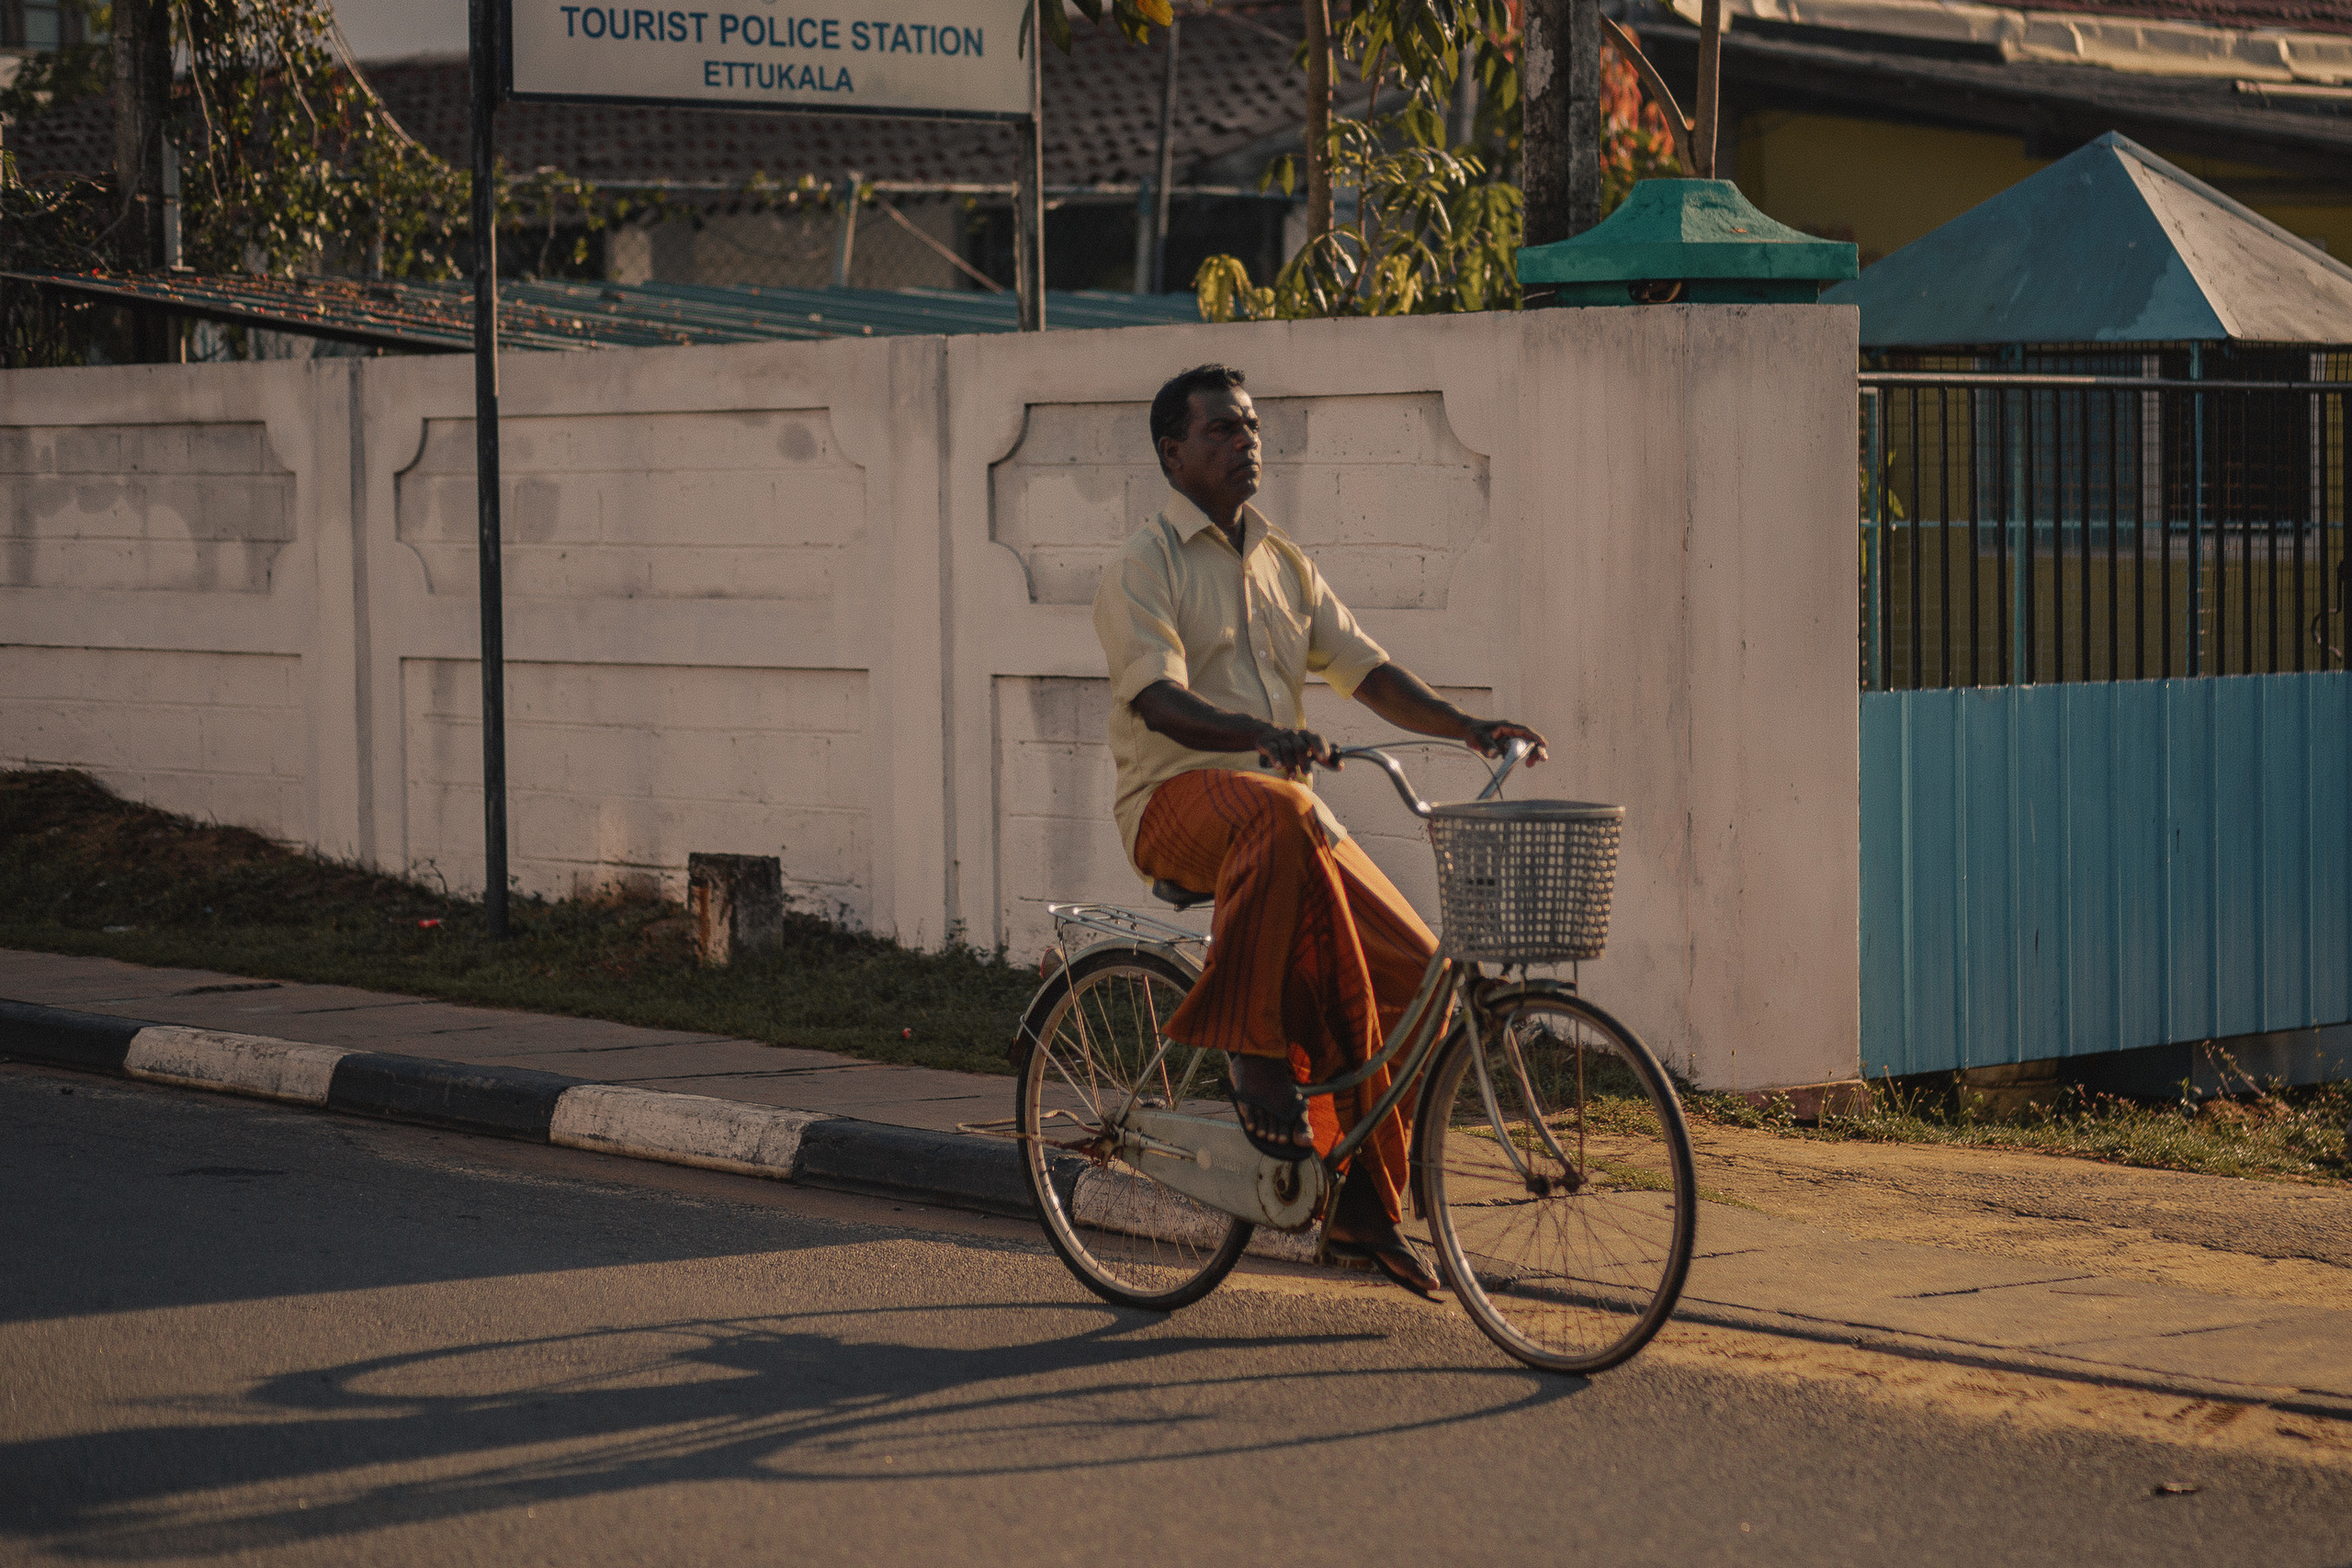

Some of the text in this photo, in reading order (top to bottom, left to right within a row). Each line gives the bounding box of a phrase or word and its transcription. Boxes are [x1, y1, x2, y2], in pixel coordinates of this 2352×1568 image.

[560, 6, 983, 57] TOURIST POLICE STATION
[704, 61, 854, 93] ETTUKALA
